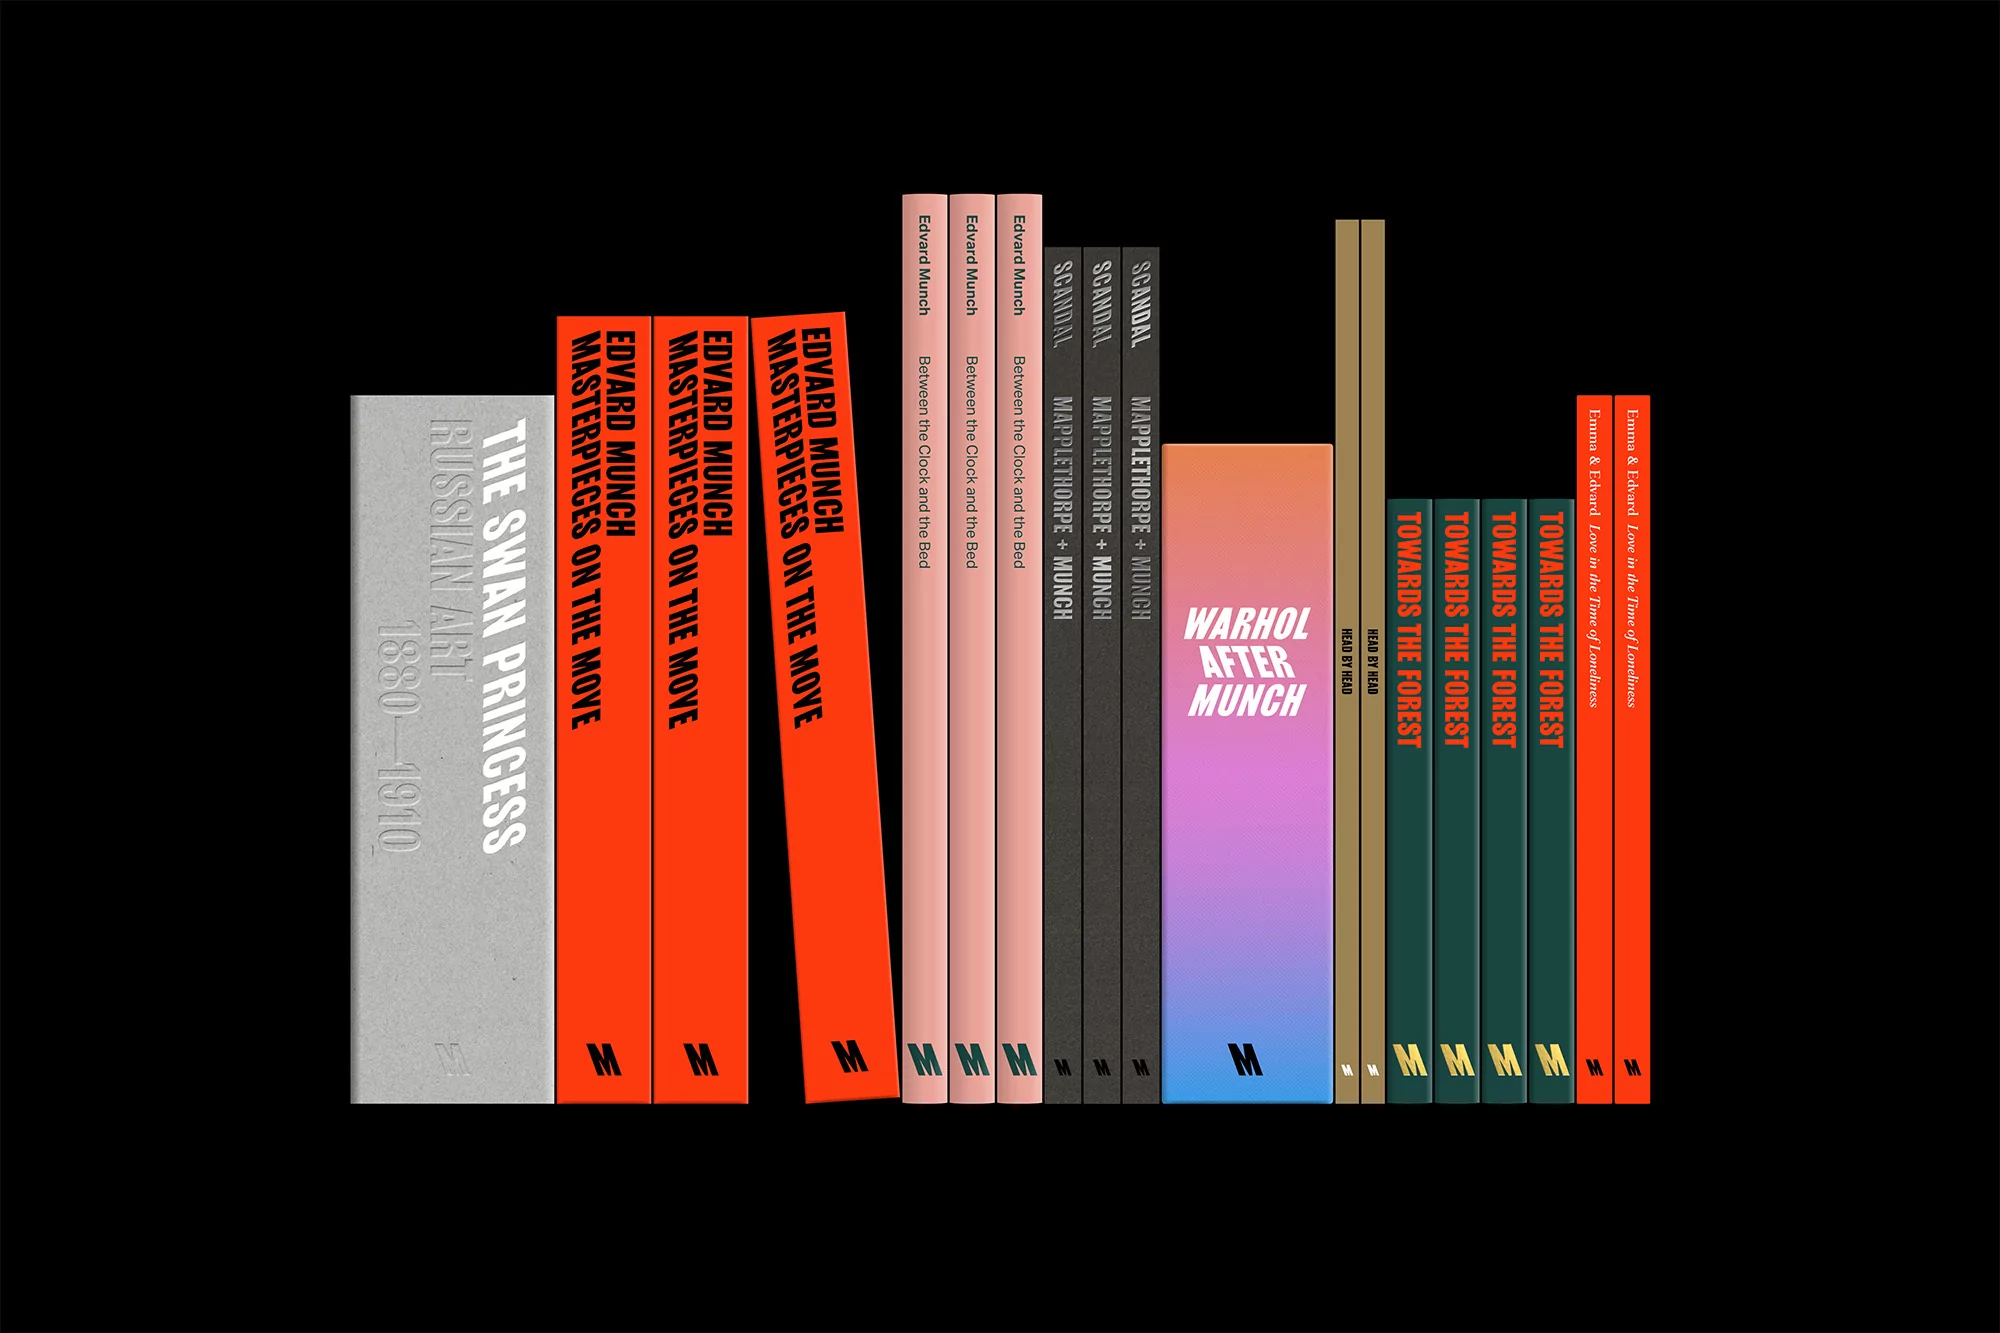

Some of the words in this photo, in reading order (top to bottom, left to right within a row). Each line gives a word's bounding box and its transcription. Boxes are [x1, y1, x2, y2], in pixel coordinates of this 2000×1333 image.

[919, 215, 930, 264] Edvard
[966, 215, 978, 264] Edvard
[1014, 215, 1025, 264] Edvard
[919, 269, 930, 315] Munch
[966, 269, 978, 315] Munch
[1014, 269, 1025, 315] Munch
[1053, 260, 1073, 348] SCANDAL
[1092, 260, 1112, 348] SCANDAL
[1131, 260, 1151, 348] SCANDAL
[606, 331, 636, 431] EDVARD
[703, 331, 733, 431] EDVARD
[801, 327, 837, 429] EDVARD
[919, 356, 931, 415] Between
[966, 356, 978, 415] Between
[1014, 356, 1025, 415] Between
[572, 330, 601, 539] MASTERPIECES
[669, 330, 698, 539] MASTERPIECES
[767, 329, 809, 539] MASTERPIECES
[919, 419, 930, 441] the
[966, 419, 978, 441] the
[1014, 419, 1025, 441] the
[1589, 409, 1601, 451] Emma
[1627, 409, 1639, 451] Emma
[482, 417, 527, 505] THE
[919, 445, 931, 484] Clock
[966, 445, 978, 484] Clock
[1014, 445, 1026, 484] Clock
[1053, 396, 1073, 533] MAPPLETHORPE
[1092, 396, 1112, 533] MAPPLETHORPE
[1131, 396, 1151, 533] MAPPLETHORPE
[1589, 456, 1601, 465] &
[1627, 456, 1639, 465] &
[606, 441, 636, 536] MUNCH
[703, 441, 733, 536] MUNCH
[809, 437, 845, 534] MUNCH
[919, 488, 930, 512] and
[966, 488, 978, 512] and
[1014, 488, 1025, 512] and
[1589, 470, 1601, 516] Edvard
[1627, 470, 1639, 516] Edvard
[430, 418, 475, 594] RUSSIAN
[919, 516, 930, 538] the
[966, 516, 978, 538] the
[1014, 516, 1025, 538] the
[1589, 524, 1601, 553] Love
[1627, 524, 1639, 553] Love
[482, 509, 527, 638] SWAN
[572, 544, 601, 588] ON
[669, 544, 698, 588] ON
[782, 543, 814, 588] ON
[919, 542, 931, 568] Bed
[966, 542, 978, 568] Bed
[1014, 542, 1025, 568] Bed
[1397, 511, 1422, 617] TOWARDS
[1444, 511, 1469, 617] TOWARDS
[1492, 511, 1517, 617] TOWARDS
[1539, 511, 1564, 617] TOWARDS
[1589, 557, 1601, 569] in
[1627, 557, 1639, 569] in
[1053, 556, 1073, 620] MUNCH
[1092, 556, 1112, 620] MUNCH
[1131, 556, 1151, 620] MUNCH
[1589, 574, 1601, 593] the
[1627, 574, 1639, 593] the
[572, 588, 601, 645] THE
[669, 588, 698, 645] THE
[784, 587, 817, 644] THE
[1184, 607, 1310, 640] WARHOL
[1589, 596, 1601, 627] Time
[1627, 596, 1639, 627] Time
[430, 604, 475, 684] ART
[1342, 629, 1352, 652] HEAD
[1368, 629, 1378, 652] HEAD
[1397, 623, 1422, 662] THE
[1444, 623, 1469, 662] THE
[1492, 623, 1517, 662] THE
[1539, 623, 1564, 662] THE
[1586, 629, 1601, 643] of
[1624, 629, 1639, 643] of
[1199, 645, 1296, 678] AFTER
[1342, 656, 1352, 668] BY
[1368, 656, 1378, 668] BY
[1589, 645, 1602, 708] Loneliness
[1627, 645, 1640, 708] Loneliness
[572, 646, 601, 730] MOVE
[669, 646, 698, 730] MOVE
[789, 645, 823, 729] MOVE
[1188, 684, 1307, 717] MUNCH
[1342, 671, 1352, 694] HEAD
[1368, 671, 1378, 694] HEAD
[1397, 670, 1422, 748] FOREST
[1444, 670, 1469, 748] FOREST
[1492, 670, 1517, 748] FOREST
[1539, 670, 1564, 748] FOREST
[482, 642, 527, 855] PRINCESS
[435, 1043, 471, 1075] M
[586, 1043, 622, 1076] M
[683, 1043, 719, 1076] M
[831, 1039, 869, 1073] M
[907, 1043, 942, 1076] M
[954, 1043, 990, 1076] M
[1002, 1043, 1037, 1076] M
[1054, 1059, 1072, 1077] M
[1093, 1059, 1111, 1077] M
[1132, 1059, 1150, 1077] M
[1227, 1043, 1263, 1076] M
[1341, 1064, 1353, 1076] M
[1367, 1064, 1379, 1076] M
[1392, 1043, 1427, 1076] M
[1440, 1043, 1475, 1076] M
[1487, 1043, 1522, 1076] M
[1534, 1043, 1570, 1076] M
[1586, 1059, 1604, 1077] M
[1624, 1059, 1642, 1077] M
